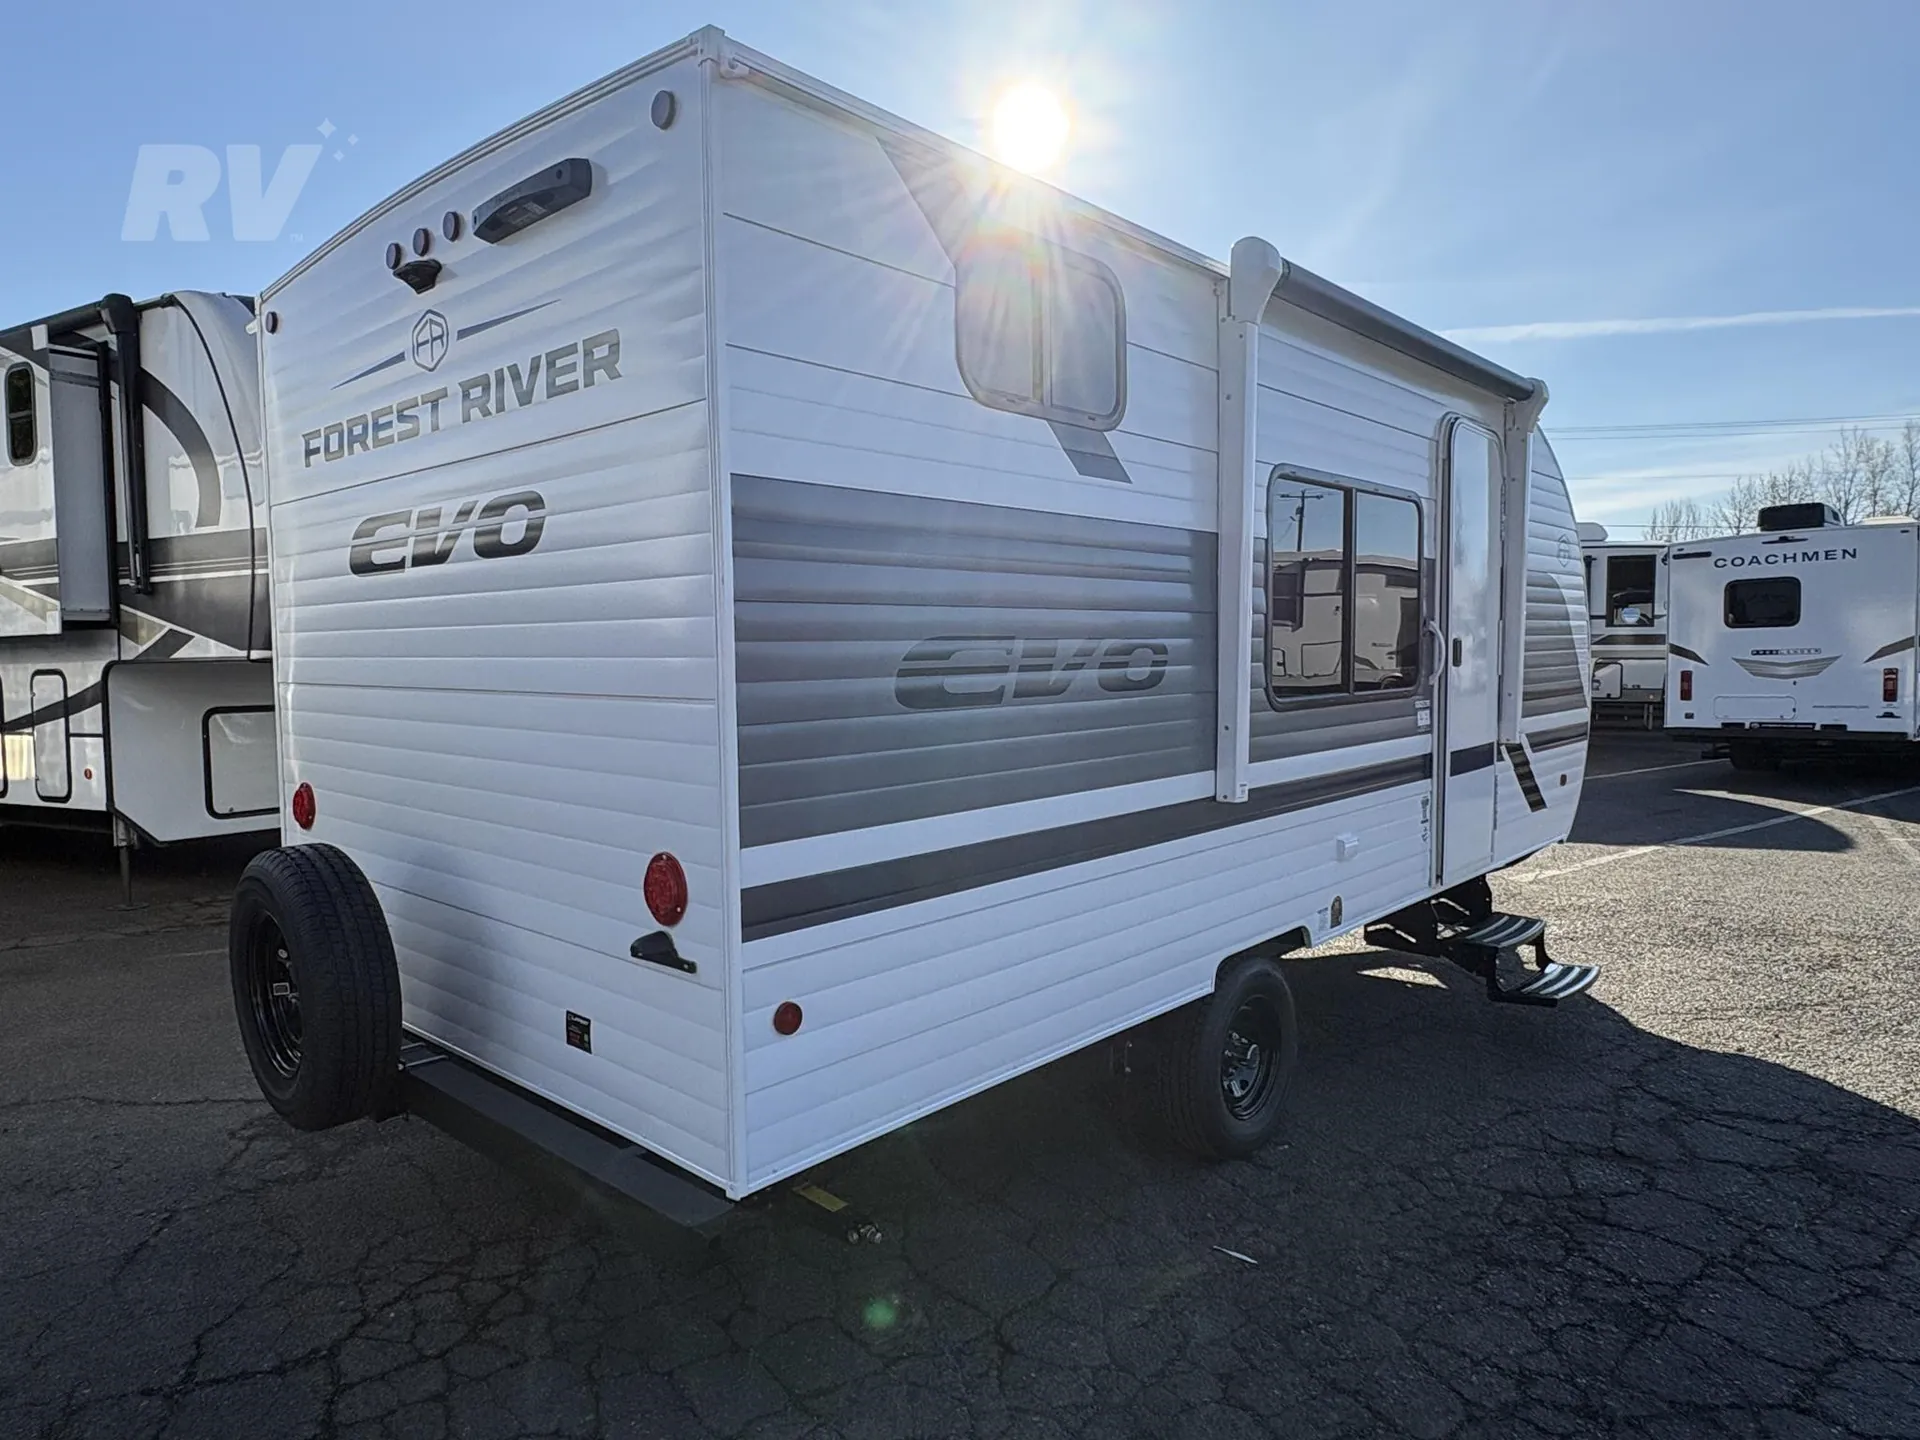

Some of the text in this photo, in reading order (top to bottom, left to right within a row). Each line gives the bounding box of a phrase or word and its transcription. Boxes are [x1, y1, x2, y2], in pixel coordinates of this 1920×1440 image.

[301, 328, 623, 468] FOREST RIVER
[349, 490, 546, 577] EVO
[1714, 548, 1857, 568] COACHMEN
[894, 635, 1168, 709] EVO
